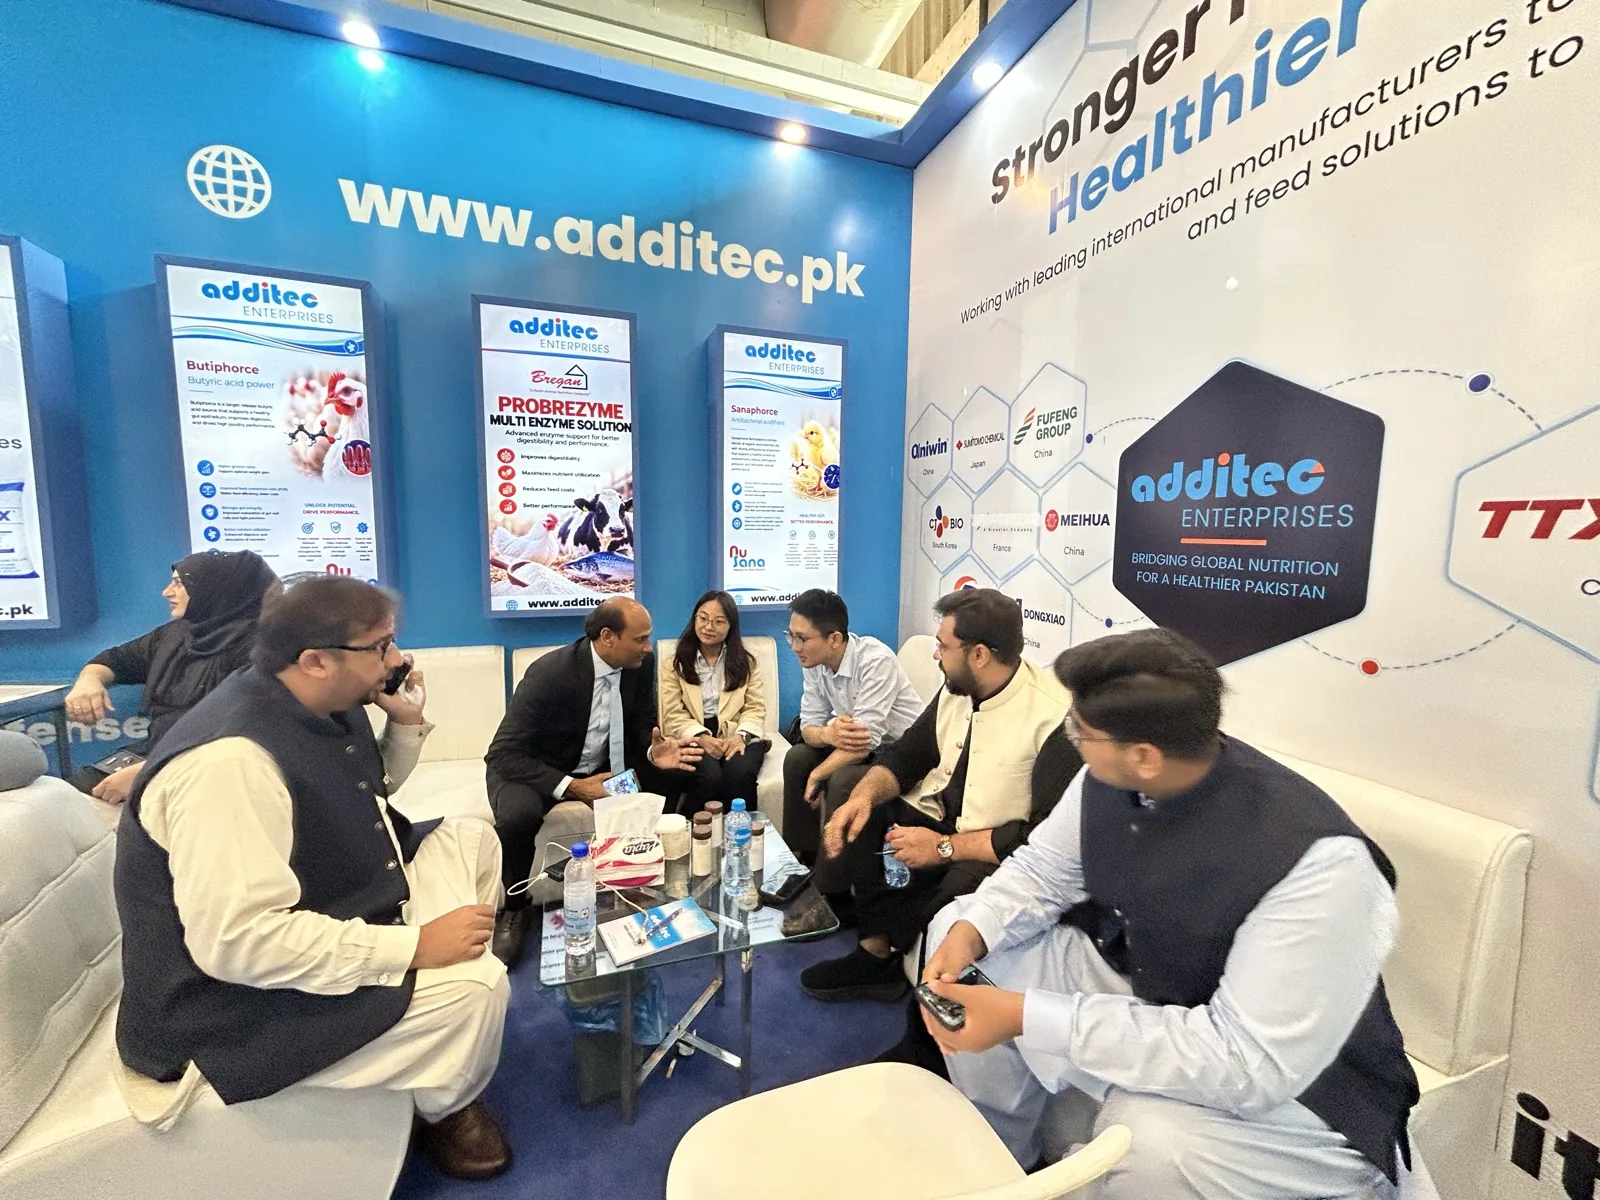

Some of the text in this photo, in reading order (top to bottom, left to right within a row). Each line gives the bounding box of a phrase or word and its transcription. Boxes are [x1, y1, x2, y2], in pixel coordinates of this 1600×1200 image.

[1048, 0, 1368, 235] Healthier
[1187, 35, 1584, 240] and feed solutions to
[960, 293, 1002, 324] Working
[1004, 277, 1030, 301] with
[1033, 247, 1087, 287] leading
[1091, 168, 1222, 257] international
[1230, 18, 1508, 184] manufacturers
[337, 177, 867, 304] www.additec.pk
[201, 280, 319, 308] additec
[243, 305, 333, 324] ENTERPRISES
[509, 316, 599, 340] additec
[540, 338, 610, 354] ENTERPRISES
[745, 342, 816, 363] additec
[186, 360, 260, 374] Butiphorce
[769, 361, 825, 375] ENTERPRISES
[188, 375, 275, 389] Butyric acid power
[530, 370, 583, 389] Bregan
[498, 395, 624, 419] PROBREZYME
[731, 405, 779, 416] Sanaphorce
[1036, 406, 1078, 427] FUFENG
[489, 414, 632, 433] MULTI ENZYME SOLUTION
[1035, 422, 1071, 441] GROUP
[505, 429, 538, 437] Advanced
[540, 431, 565, 440] enzyme
[566, 432, 590, 441] support
[516, 437, 554, 447] digestibility
[569, 440, 609, 448] performance.
[548, 454, 580, 462] digestibility
[1034, 448, 1053, 460] China
[970, 460, 986, 470] Japan
[1131, 452, 1325, 503] additec
[928, 518, 964, 531] CJ BIO
[1060, 513, 1110, 527] MEIHUA
[1181, 504, 1354, 528] ENTERPRISES
[932, 541, 945, 549] South
[992, 543, 1012, 553] France
[1063, 546, 1085, 556] China
[1131, 552, 1339, 577] BRIDGING GLOBAL NUTRITION
[1136, 571, 1326, 600] FOR A HEALTHIER PAKISTAN
[1023, 609, 1066, 626] DONGXIAO
